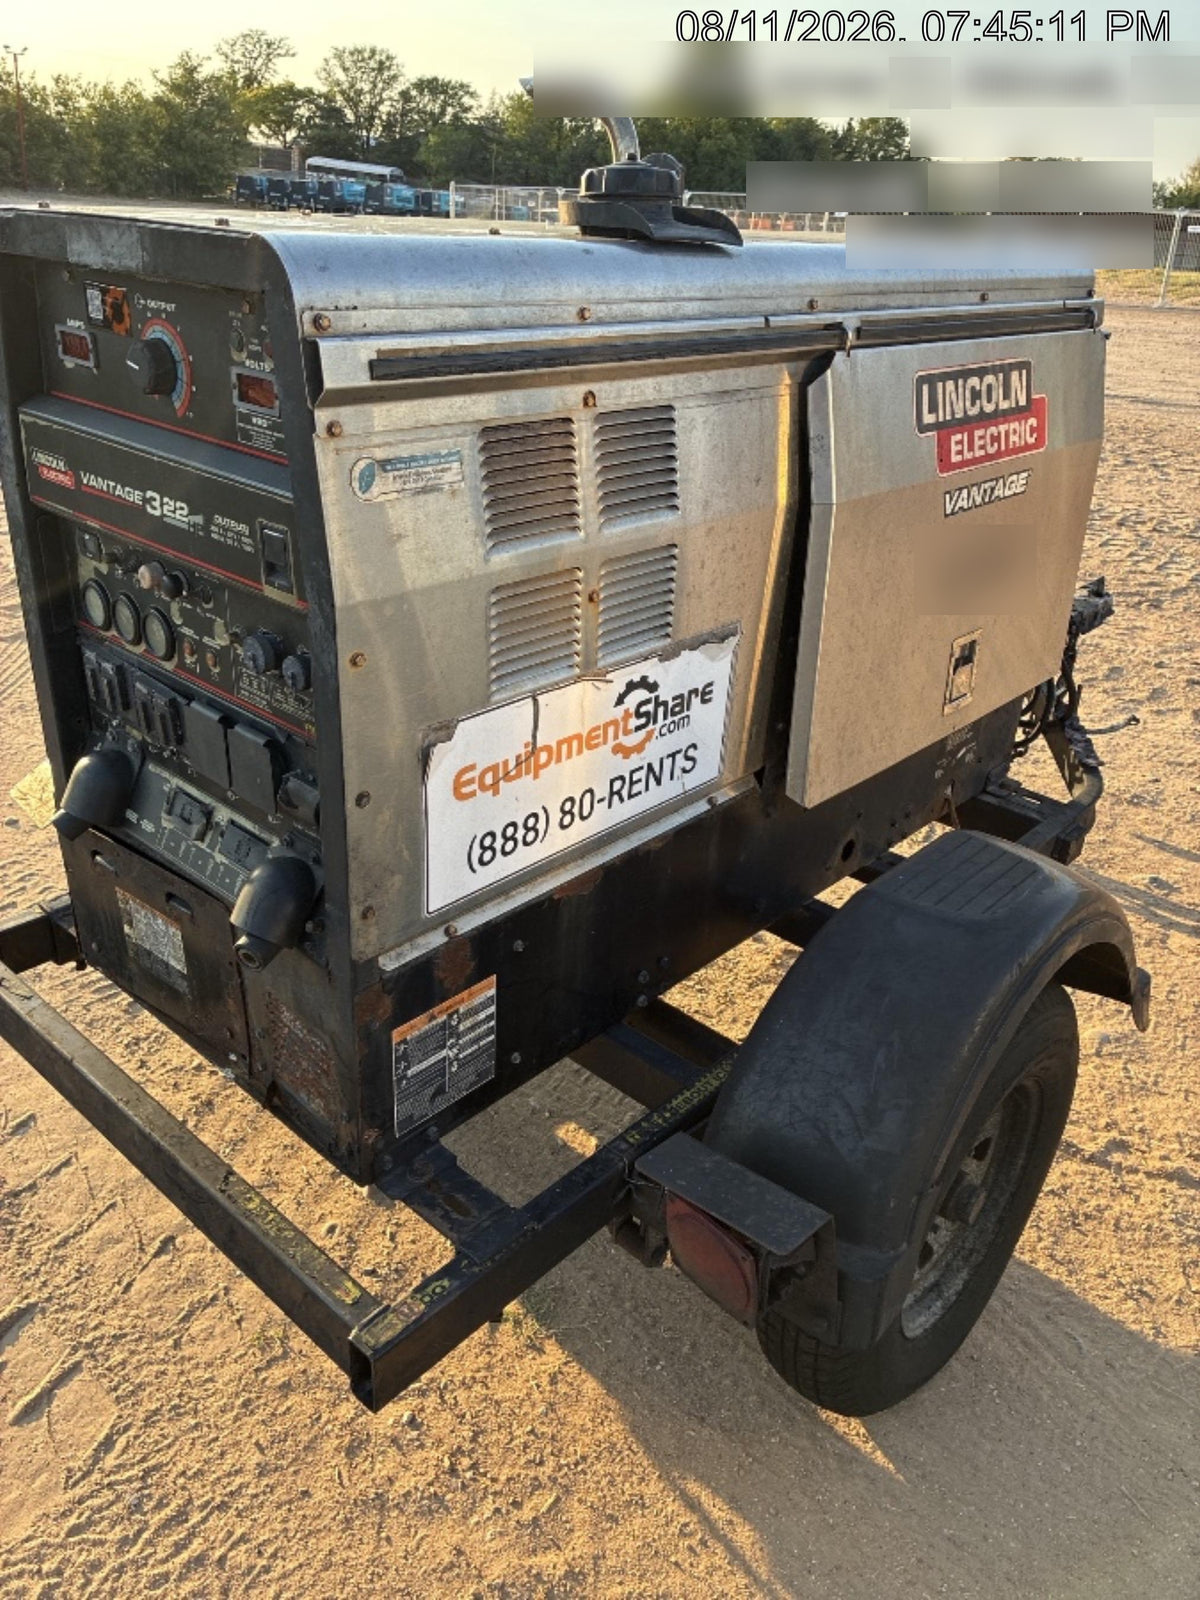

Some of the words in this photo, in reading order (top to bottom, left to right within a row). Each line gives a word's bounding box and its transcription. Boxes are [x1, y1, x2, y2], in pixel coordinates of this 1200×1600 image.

[922, 369, 1027, 424] LINCOLN
[950, 417, 1038, 463] ELECTRIC
[79, 470, 143, 506] VANTAGE
[145, 489, 190, 524] 322
[943, 470, 1030, 516] VANTAGE
[452, 680, 714, 802] EquipmentShare
[655, 713, 690, 740] .com
[467, 806, 550, 874] (888)
[558, 743, 698, 831] 80-RENTS
